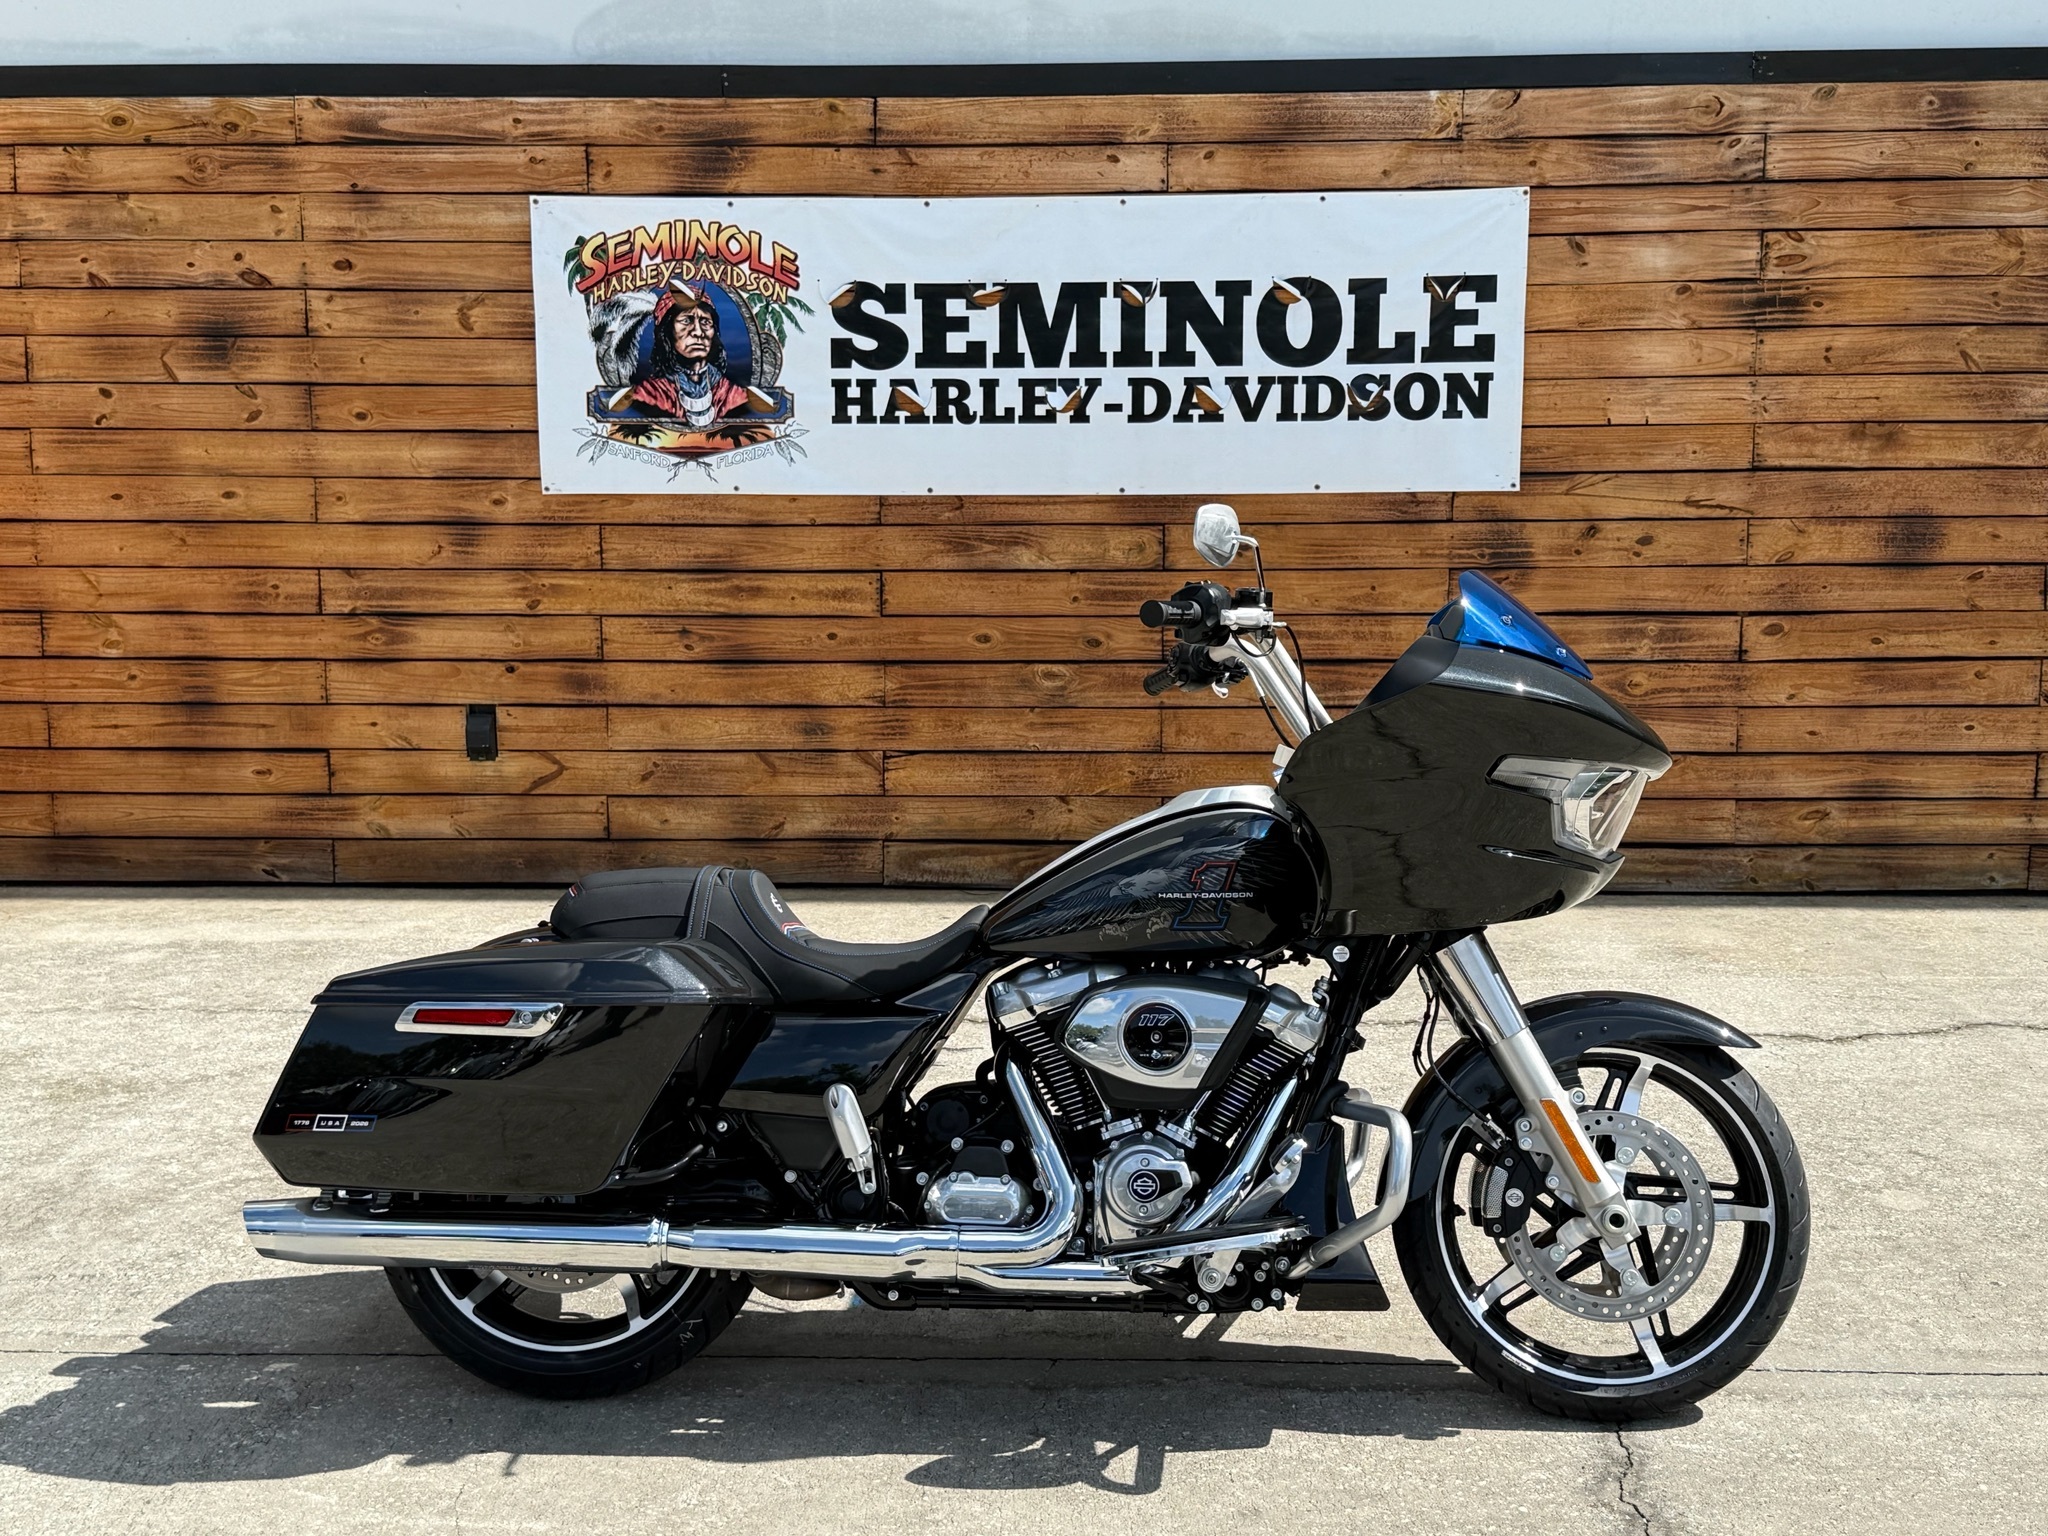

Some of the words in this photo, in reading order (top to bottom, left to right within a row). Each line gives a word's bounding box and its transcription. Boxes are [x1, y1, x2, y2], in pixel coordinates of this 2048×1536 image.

[577, 219, 800, 293] SEMINOLE
[593, 261, 788, 304] HARLEY-DAVIDSON
[831, 274, 1498, 370] SEMINOLE
[831, 372, 1494, 425] HARLEY-DAVIDSON
[716, 445, 774, 469] FLORIDA
[1158, 891, 1254, 899] HARLEY-DAVIDSON
[1138, 1013, 1175, 1027] 117
